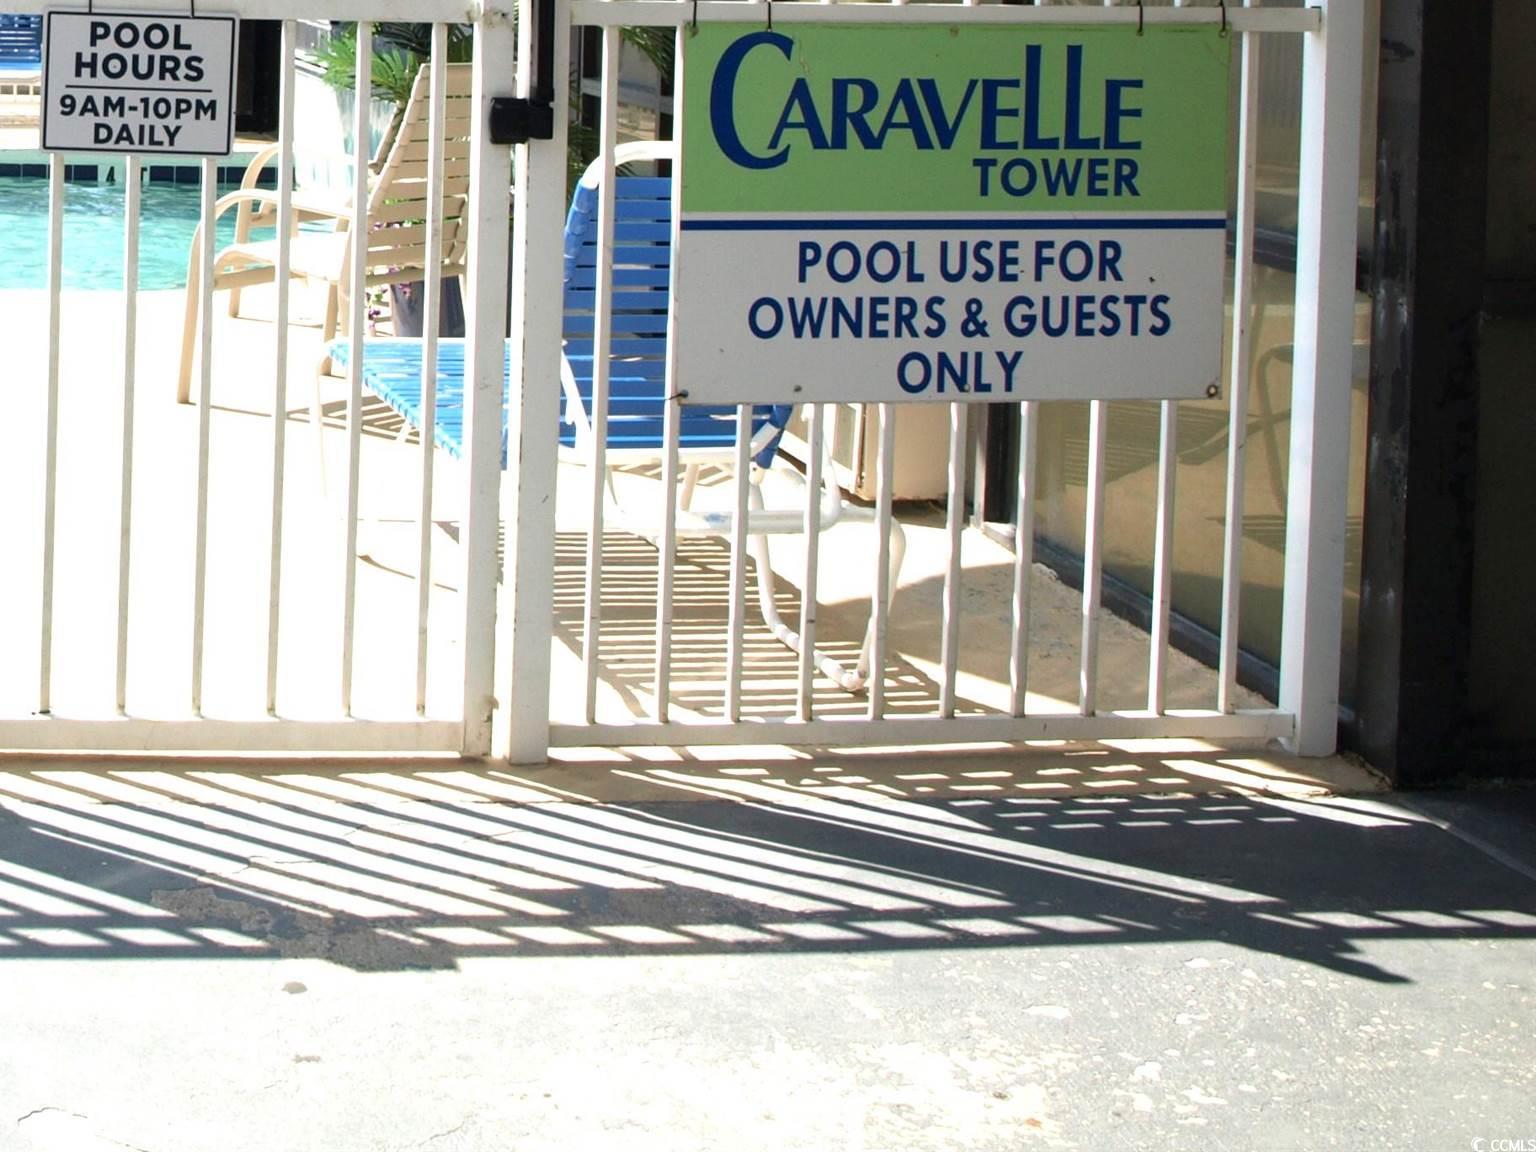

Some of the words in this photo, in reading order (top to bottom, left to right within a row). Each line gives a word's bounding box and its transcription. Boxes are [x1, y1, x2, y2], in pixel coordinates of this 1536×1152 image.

[89, 21, 192, 51] POOL
[74, 52, 204, 82] HOURS
[59, 94, 218, 121] 9AM-10PM
[709, 31, 1144, 170] CARAVELLE
[93, 122, 183, 147] DAILY
[972, 157, 1141, 198] TOWER
[797, 240, 925, 283] POOL
[939, 240, 1020, 283] USE
[1034, 239, 1124, 282] FOR
[748, 296, 947, 339] OWNERS
[960, 296, 991, 338] &
[1003, 294, 1172, 338] GUESTS
[897, 350, 1024, 394] ONLY
